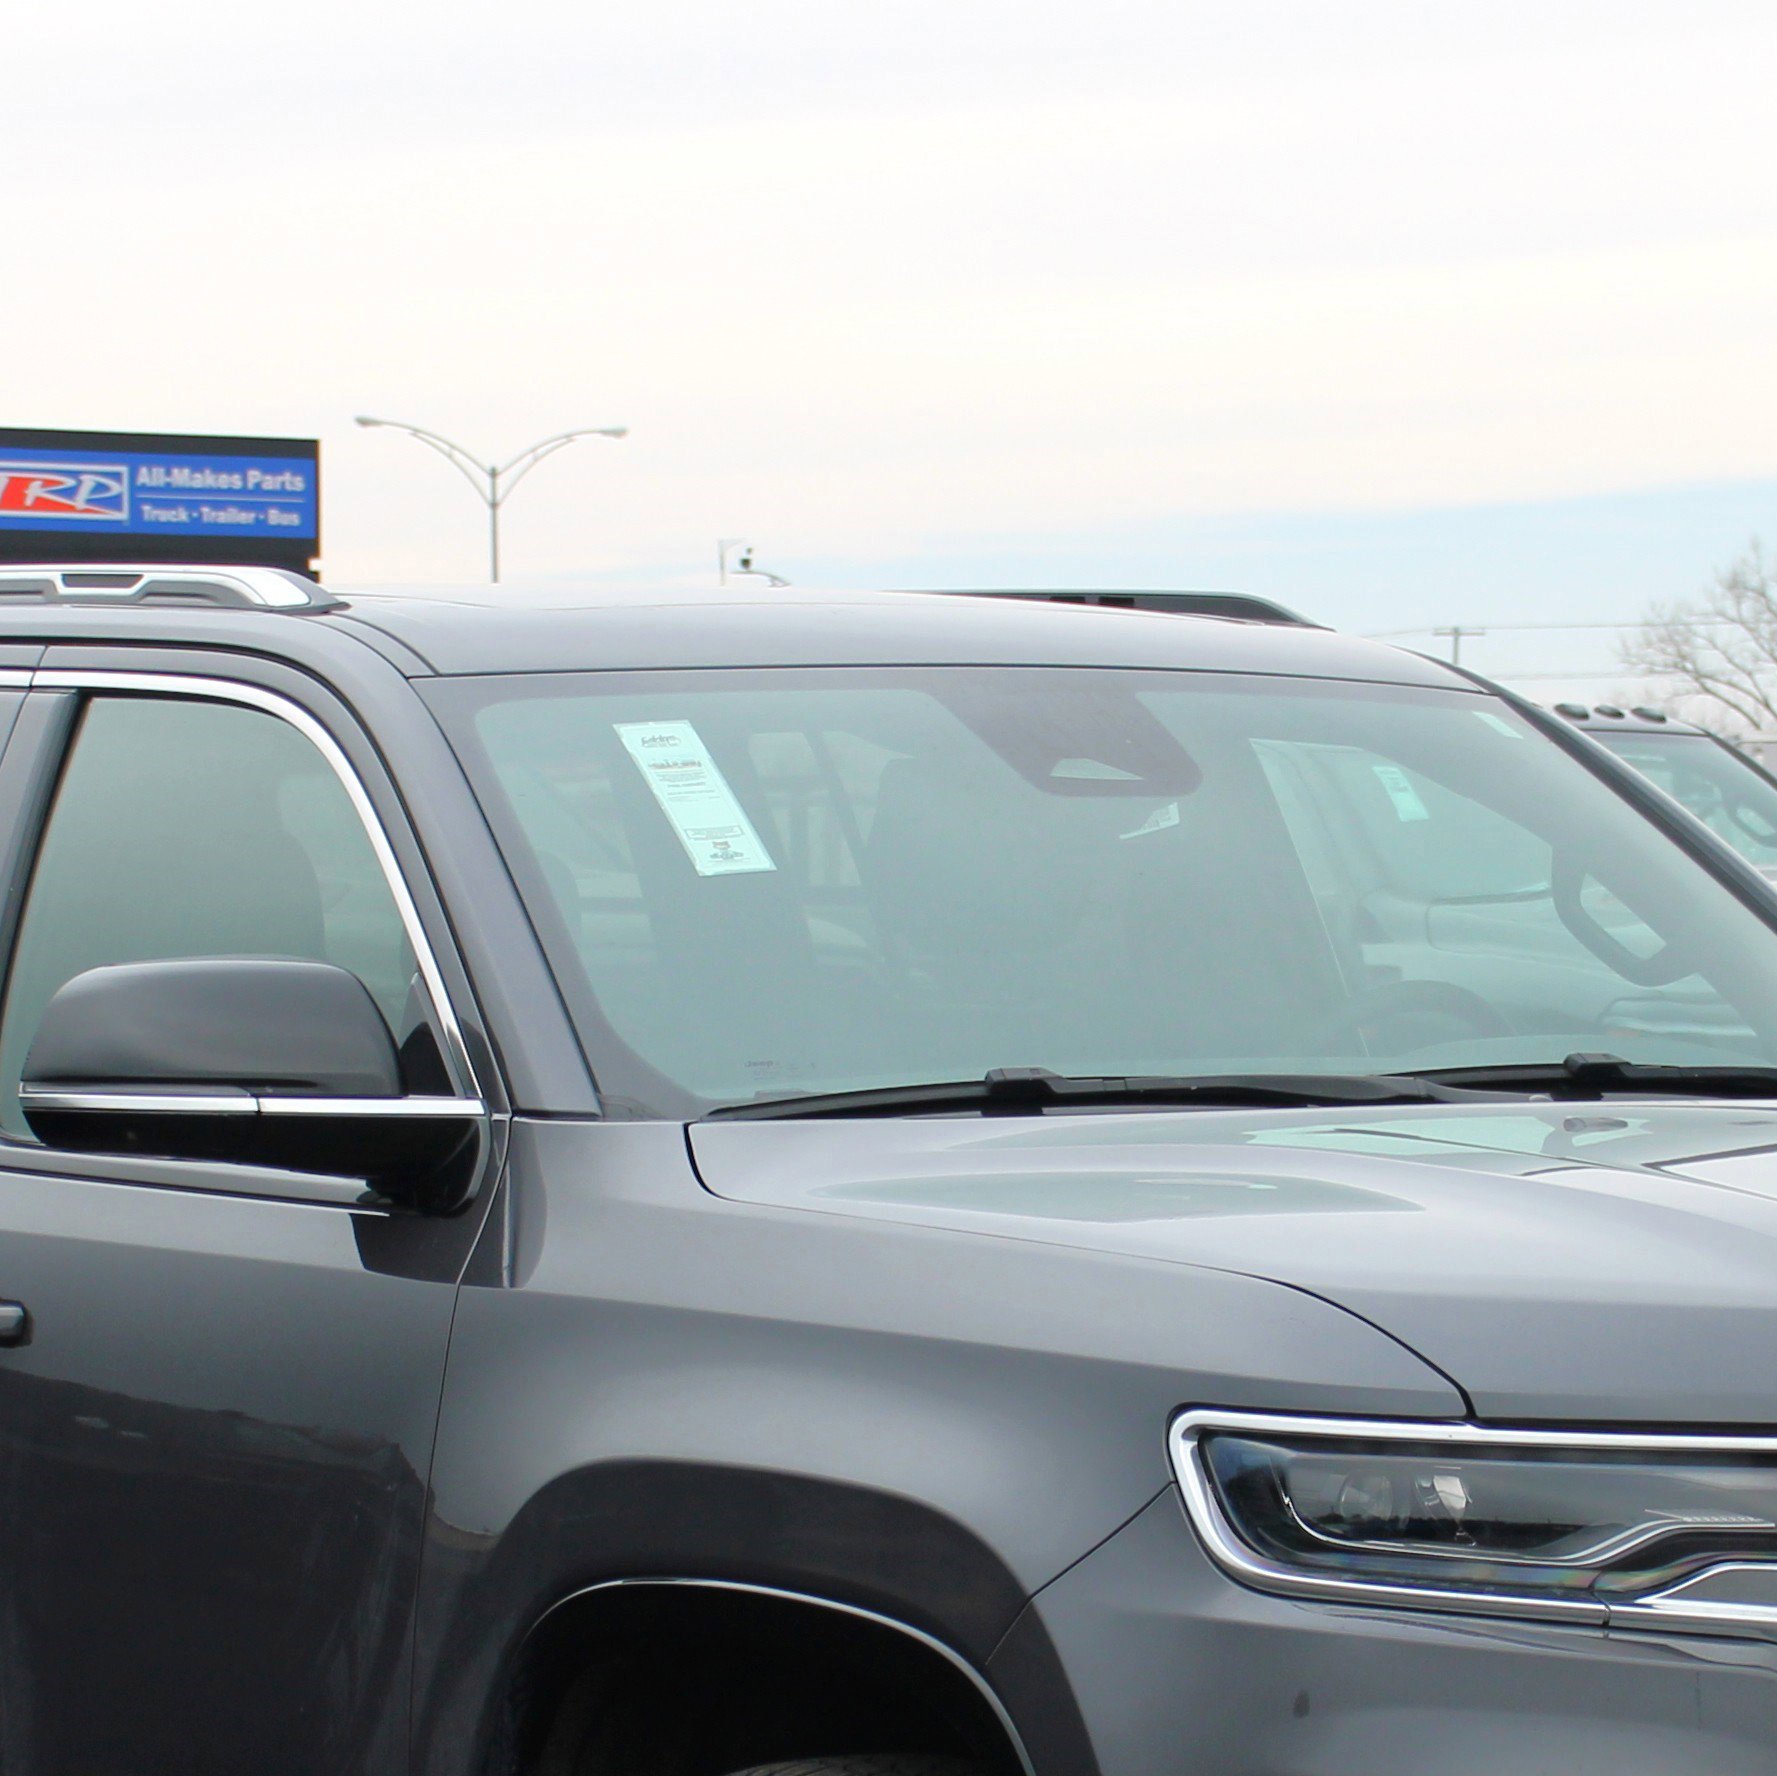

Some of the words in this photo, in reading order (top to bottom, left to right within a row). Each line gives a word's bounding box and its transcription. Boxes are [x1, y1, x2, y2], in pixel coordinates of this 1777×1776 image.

[136, 466, 242, 488] All-Makes
[246, 469, 305, 491] Parts
[141, 505, 189, 523] Truck
[200, 505, 256, 524] Trailer
[267, 508, 301, 526] Bus
